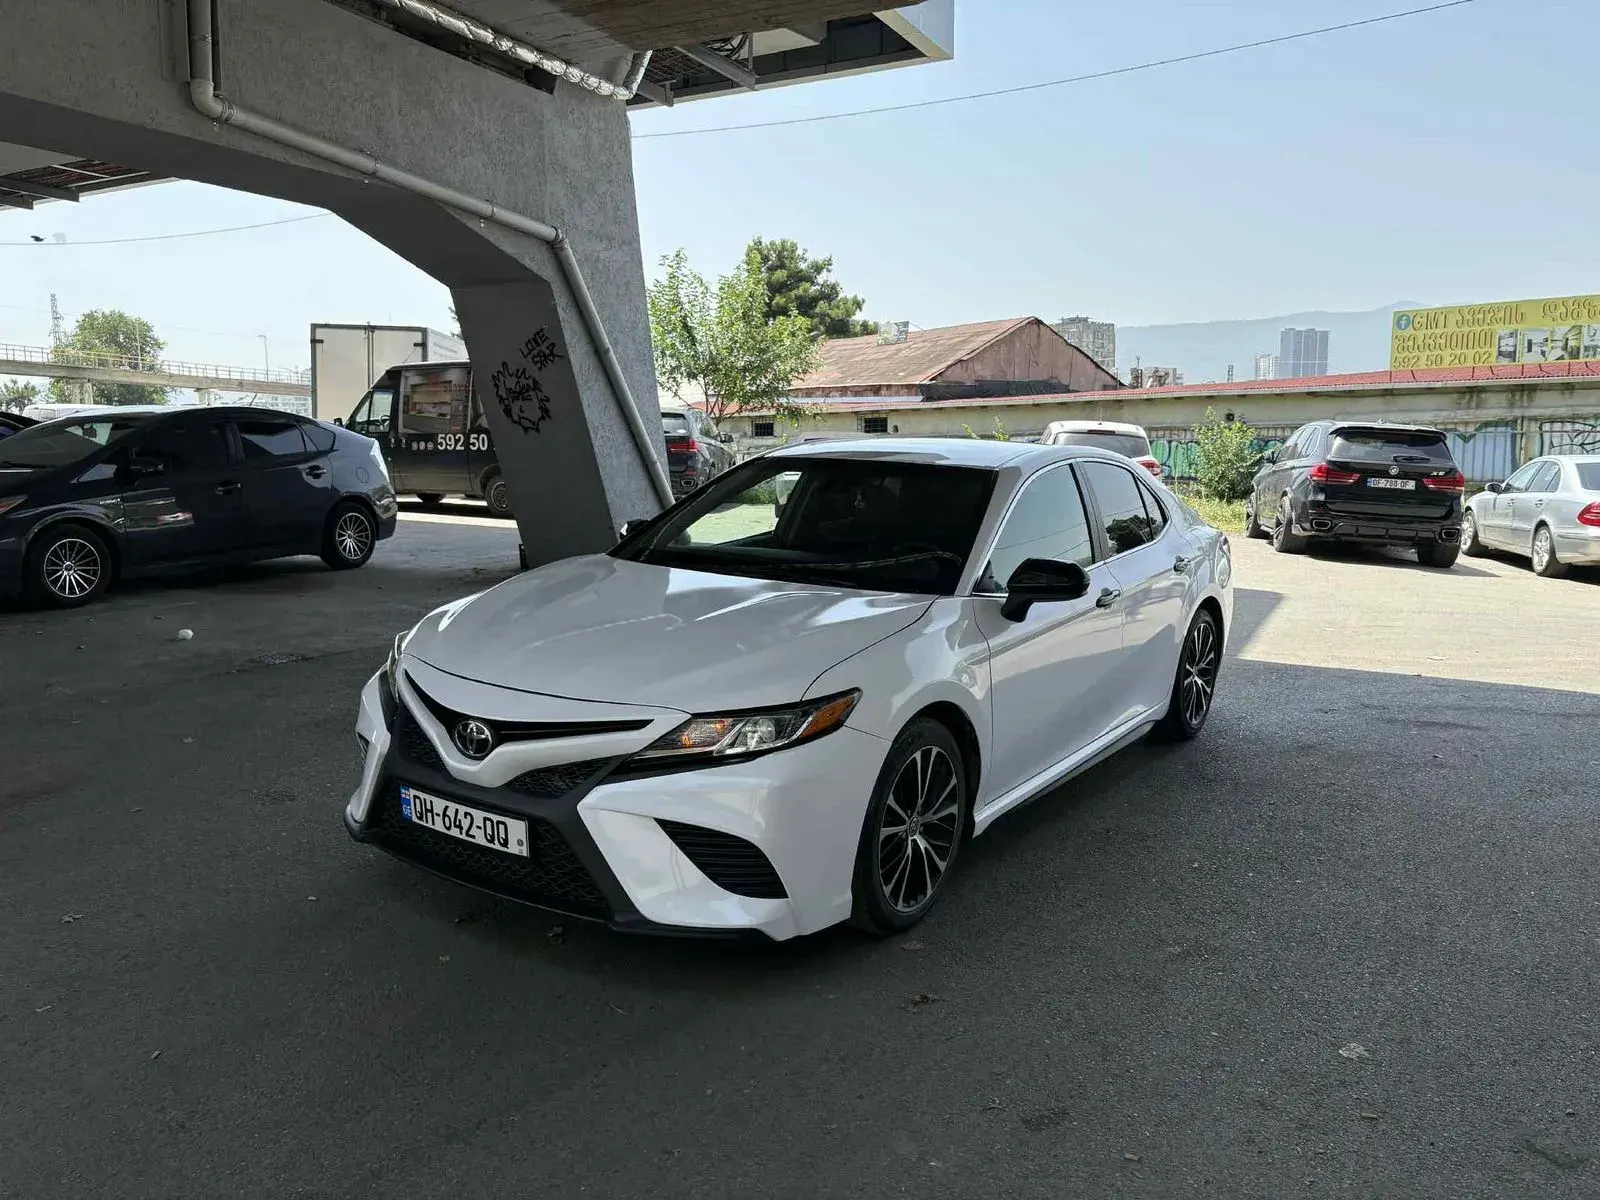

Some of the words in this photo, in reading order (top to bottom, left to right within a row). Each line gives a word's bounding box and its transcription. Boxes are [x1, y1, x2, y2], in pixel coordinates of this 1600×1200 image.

[1542, 298, 1600, 322] დამზ
[1393, 354, 1420, 369] 592
[1425, 353, 1443, 368] 50
[1448, 351, 1467, 366] 20
[1473, 350, 1492, 365] 02
[437, 433, 465, 451] 592
[469, 433, 488, 451] 50
[413, 794, 509, 849] QH-642-QQ
